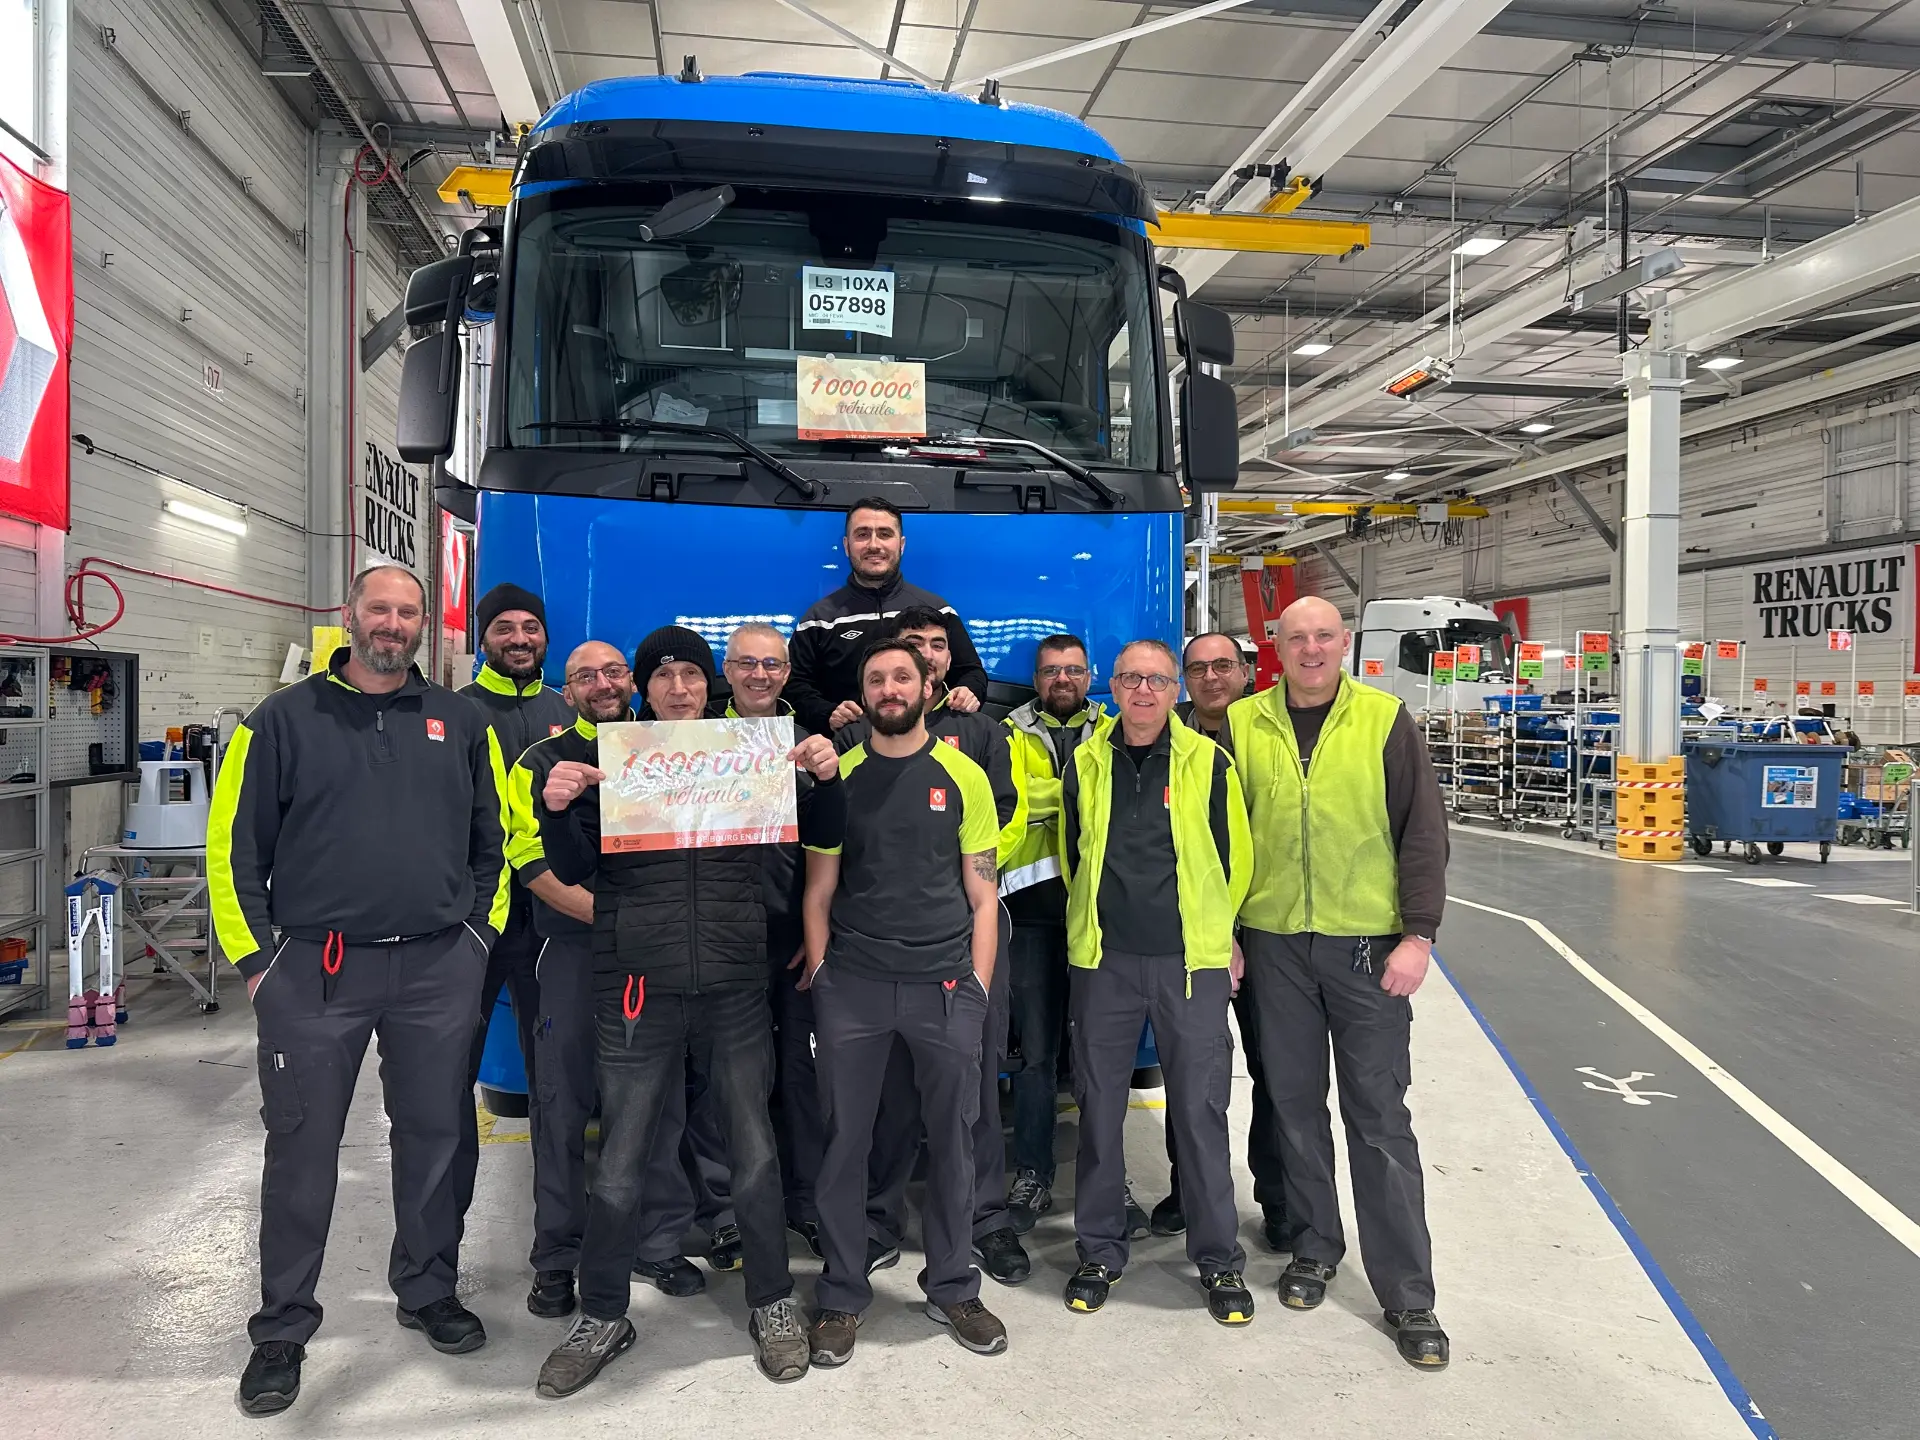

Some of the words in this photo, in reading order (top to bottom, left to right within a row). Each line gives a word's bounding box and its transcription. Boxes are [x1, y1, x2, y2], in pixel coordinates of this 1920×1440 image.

[815, 276, 833, 289] L3
[843, 276, 889, 292] 10XA
[809, 294, 886, 316] 057898
[838, 400, 892, 416] véhicule
[1753, 555, 1906, 604] RENAULT
[1759, 597, 1893, 639] TRUCKS
[665, 779, 746, 806] véhicule
[709, 833, 739, 842] BOURG
[740, 832, 752, 841] EN
[753, 831, 785, 840] BESE
